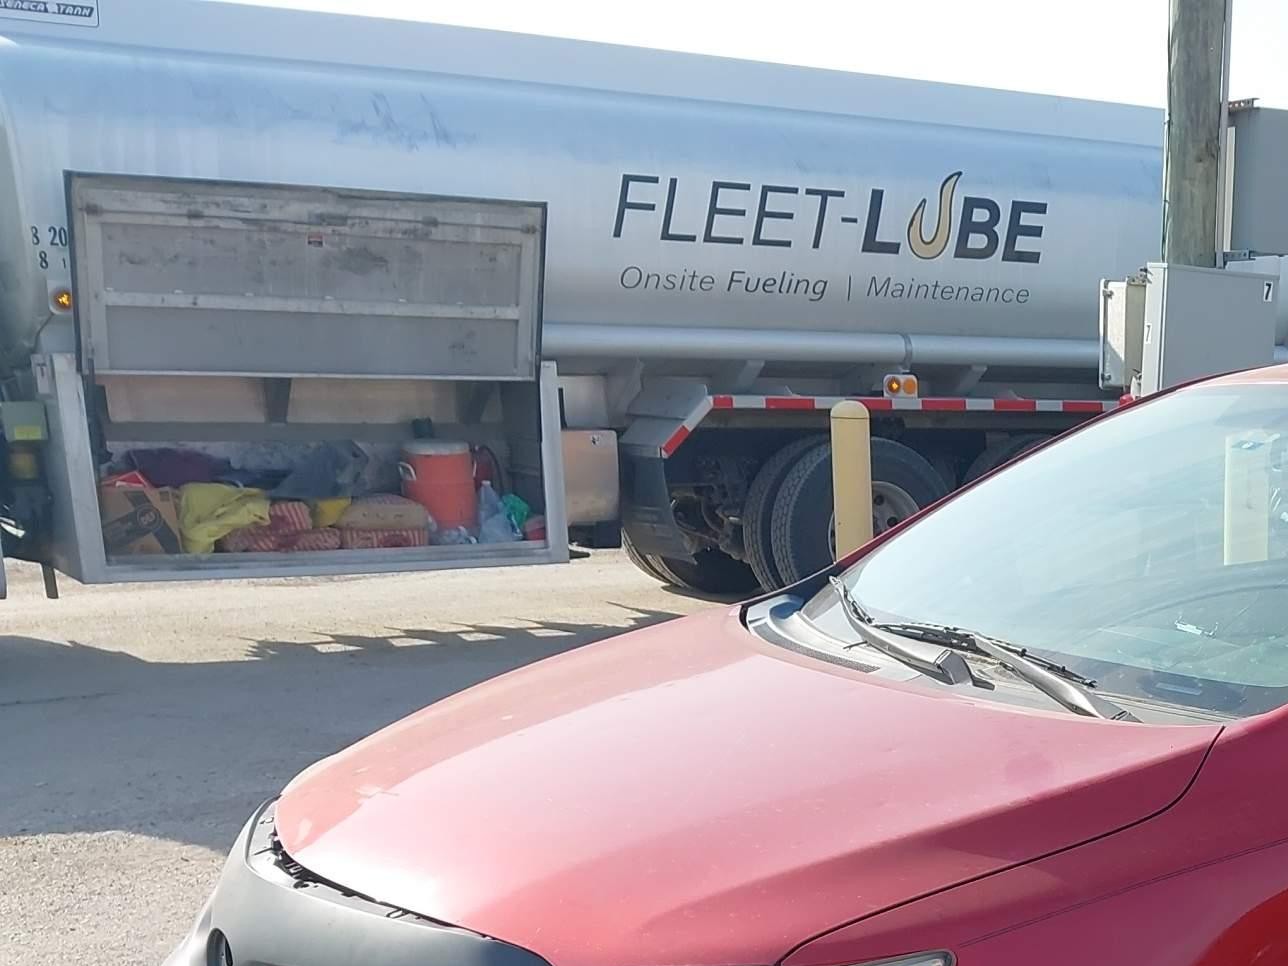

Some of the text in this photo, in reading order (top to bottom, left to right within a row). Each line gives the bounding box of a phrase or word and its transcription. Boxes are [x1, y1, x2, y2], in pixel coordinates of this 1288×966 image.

[612, 171, 1048, 264] FLEET-LUBE
[619, 266, 715, 292] Onsite
[727, 271, 828, 301] Fueling
[866, 276, 1030, 304] Maintenance
[1265, 283, 1272, 301] 7
[1146, 324, 1151, 342] 7
